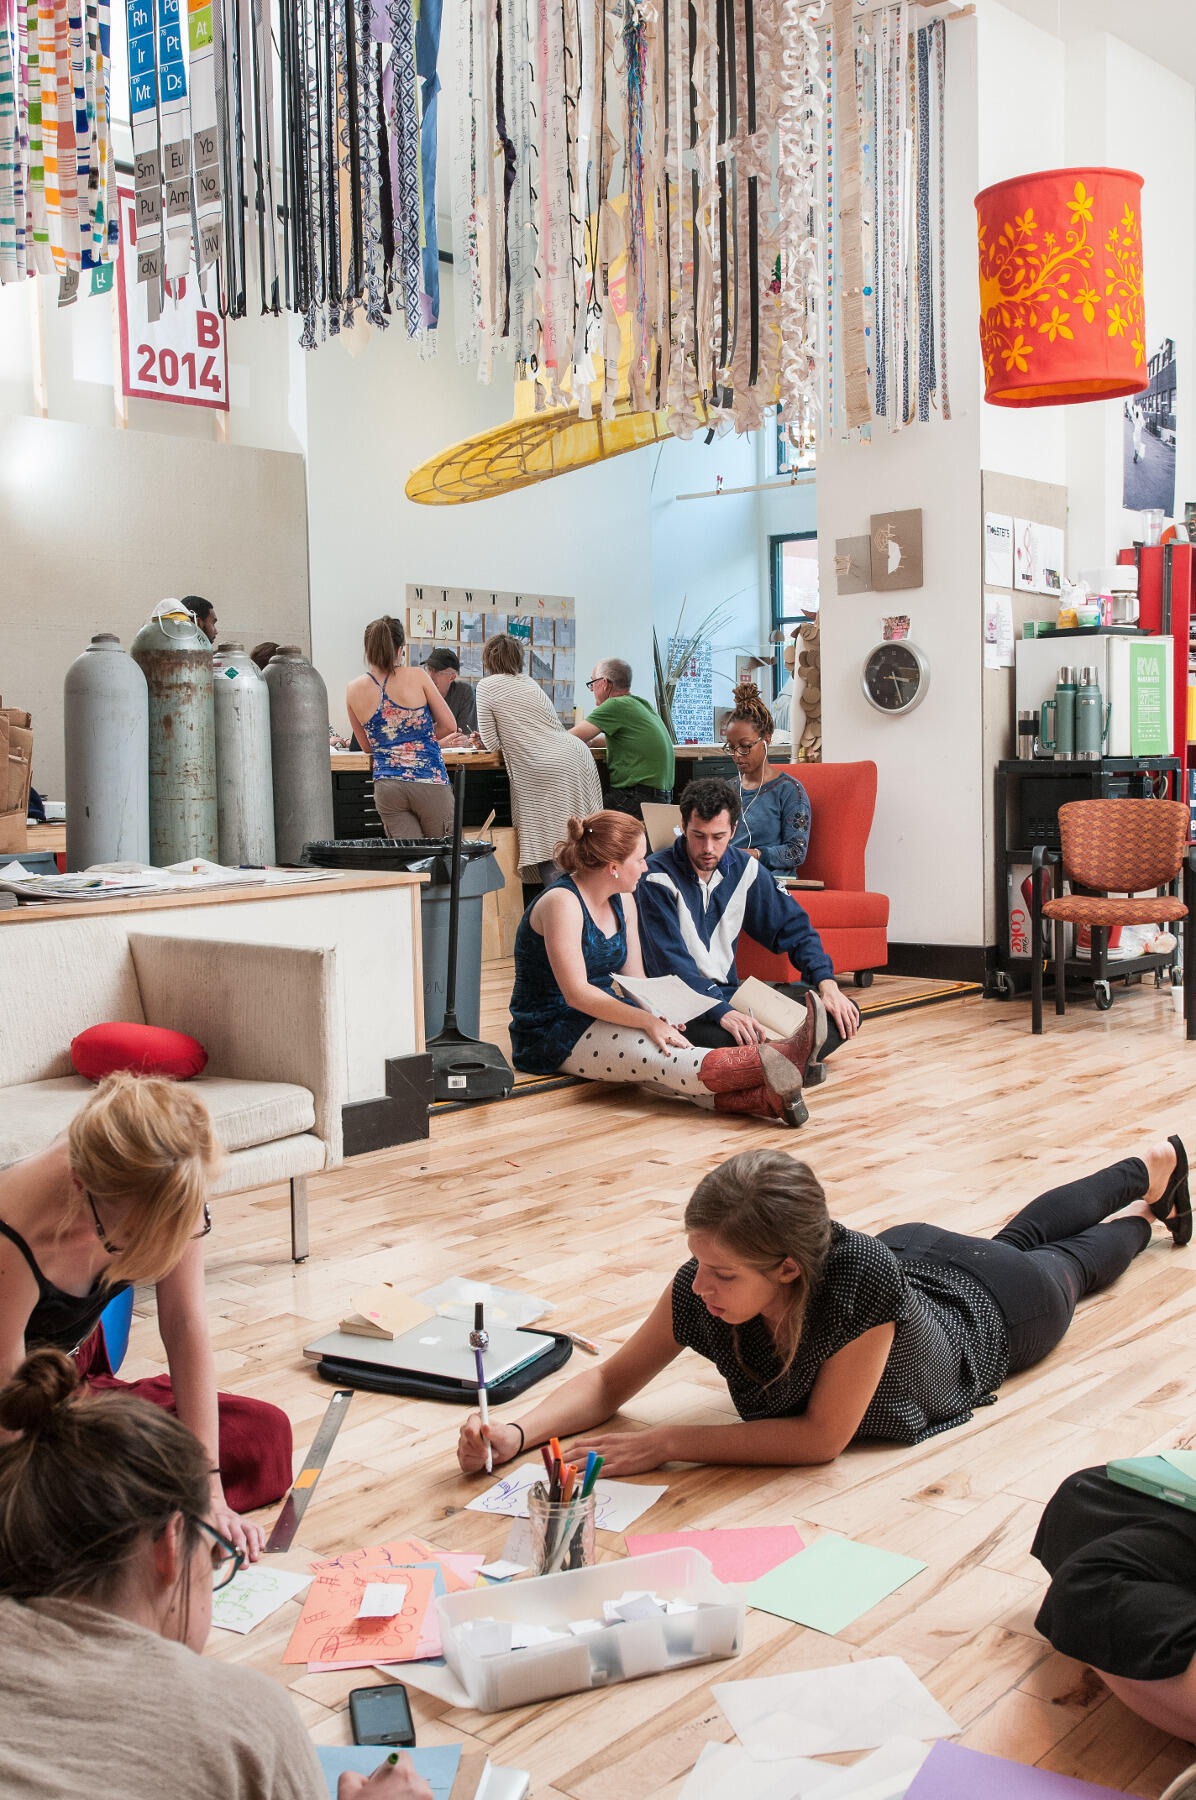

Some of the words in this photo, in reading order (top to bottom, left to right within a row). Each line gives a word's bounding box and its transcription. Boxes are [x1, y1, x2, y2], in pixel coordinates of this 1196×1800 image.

[133, 9, 148, 27] Rh
[196, 22, 208, 38] At
[166, 36, 180, 52] Pt
[138, 49, 146, 64] Ir
[166, 74, 182, 91] Ds
[136, 84, 151, 102] Mt
[200, 137, 214, 156] Yb
[171, 152, 184, 168] Eu
[137, 163, 155, 179] Sm
[201, 177, 216, 193] No
[169, 190, 190, 206] Am
[140, 199, 154, 215] Pu
[196, 310, 221, 349] B
[137, 343, 222, 393] 2014
[415, 588, 423, 600] M
[440, 590, 449, 601] T
[465, 592, 473, 603] W
[490, 594, 498, 605] T
[1136, 656, 1160, 675] RVA
[1010, 909, 1026, 953] Coke
